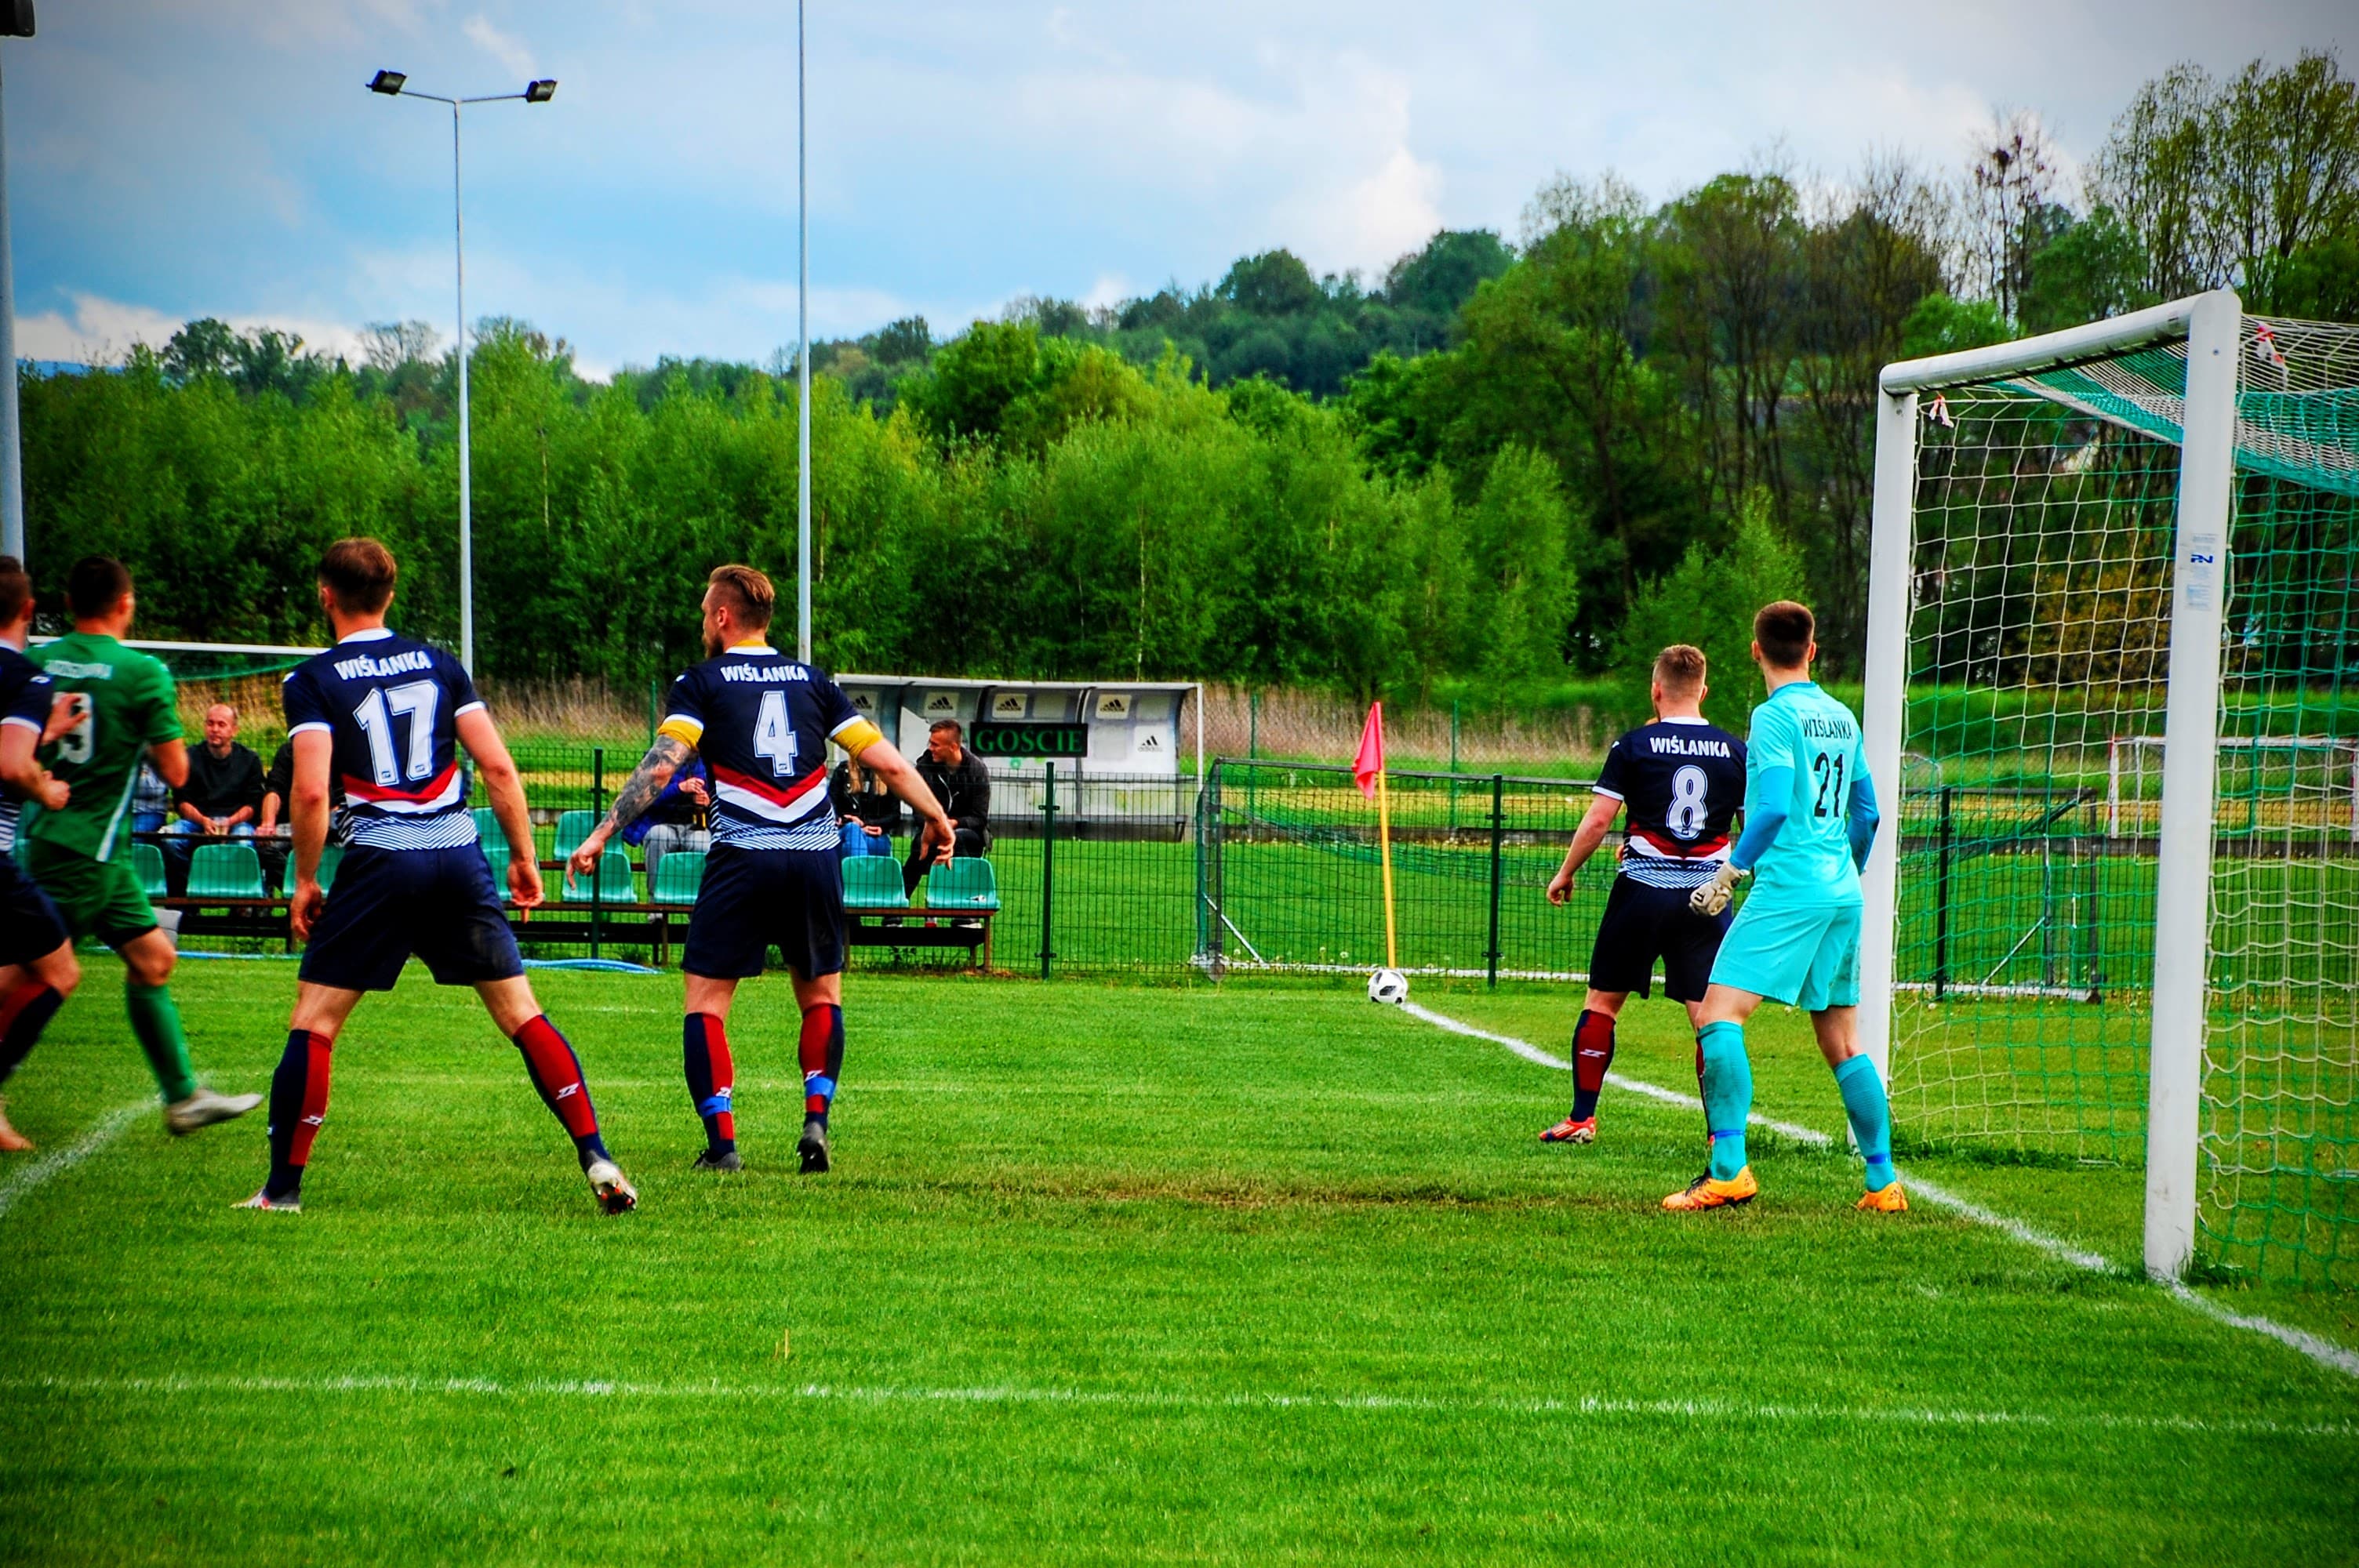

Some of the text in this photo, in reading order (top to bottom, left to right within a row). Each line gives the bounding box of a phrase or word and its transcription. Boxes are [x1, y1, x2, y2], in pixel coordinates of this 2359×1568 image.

[333, 650, 433, 681] WIŚLANKA
[720, 662, 809, 682] WIŚLANKA
[352, 679, 438, 787] 17
[752, 690, 798, 778] 4
[975, 725, 1083, 753] GOŚCIE
[1801, 713, 1852, 740] WIŚLANKA
[1649, 735, 1731, 758] WIŚLANKA
[1813, 752, 1843, 818] 21
[1666, 764, 1709, 841] 8
